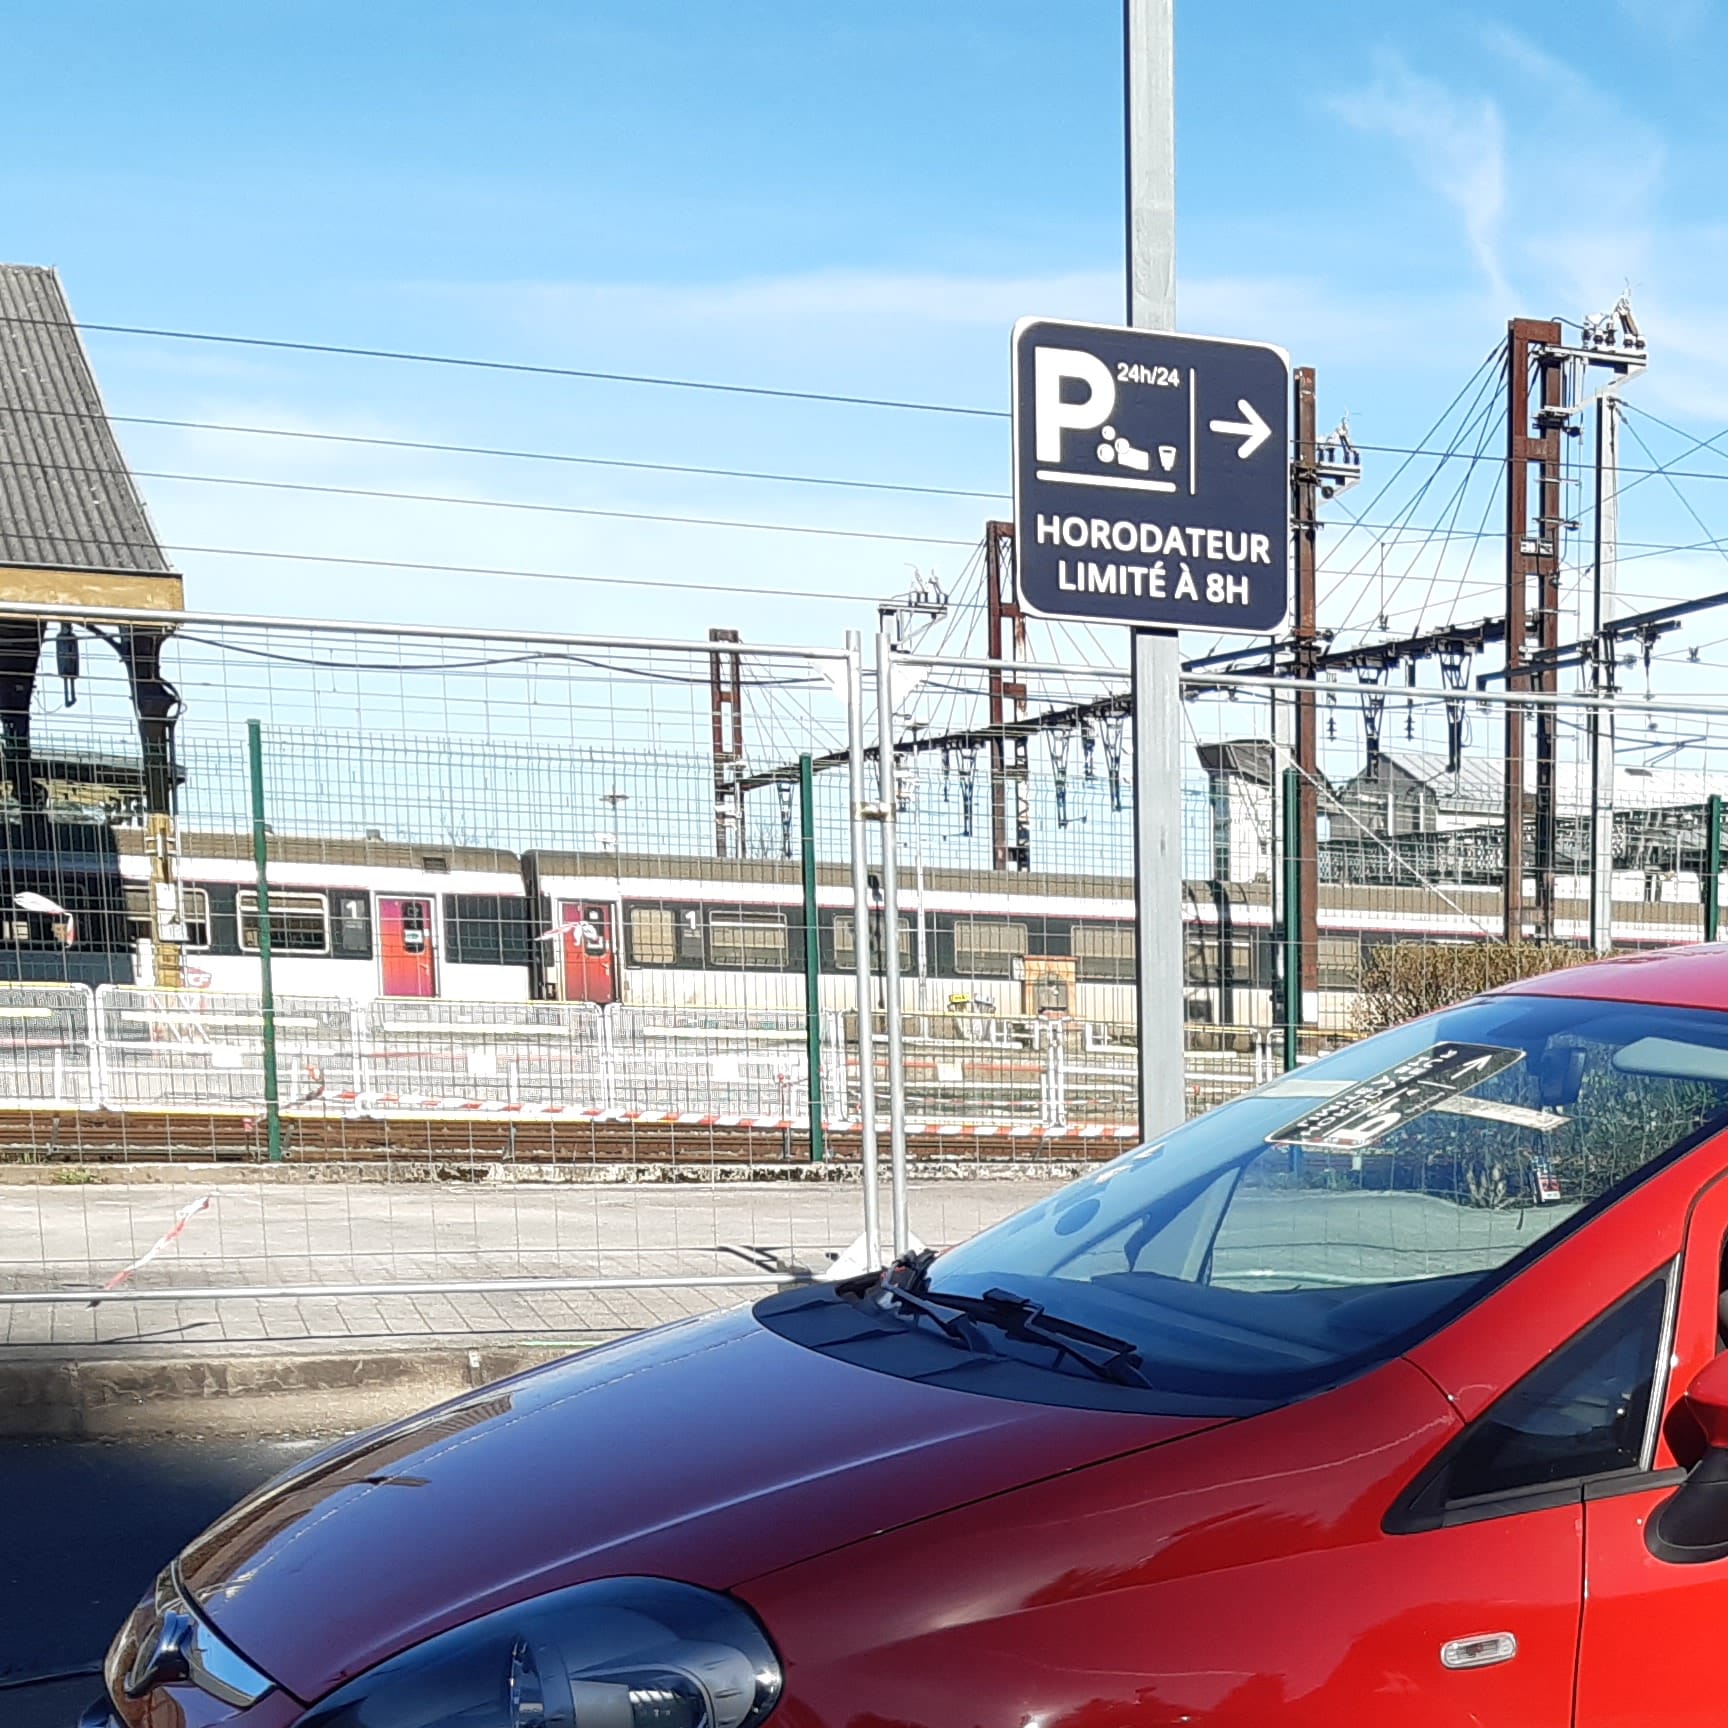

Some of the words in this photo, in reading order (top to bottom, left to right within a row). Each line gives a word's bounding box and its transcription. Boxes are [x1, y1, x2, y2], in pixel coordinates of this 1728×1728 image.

[1117, 362, 1180, 387] 24h/24
[1034, 346, 1115, 463] P
[1036, 513, 1271, 564] HORODATEUR
[1058, 560, 1166, 598] LIMITÉ
[1174, 562, 1198, 601] À
[1206, 574, 1249, 605] 8H
[685, 910, 697, 930] 1
